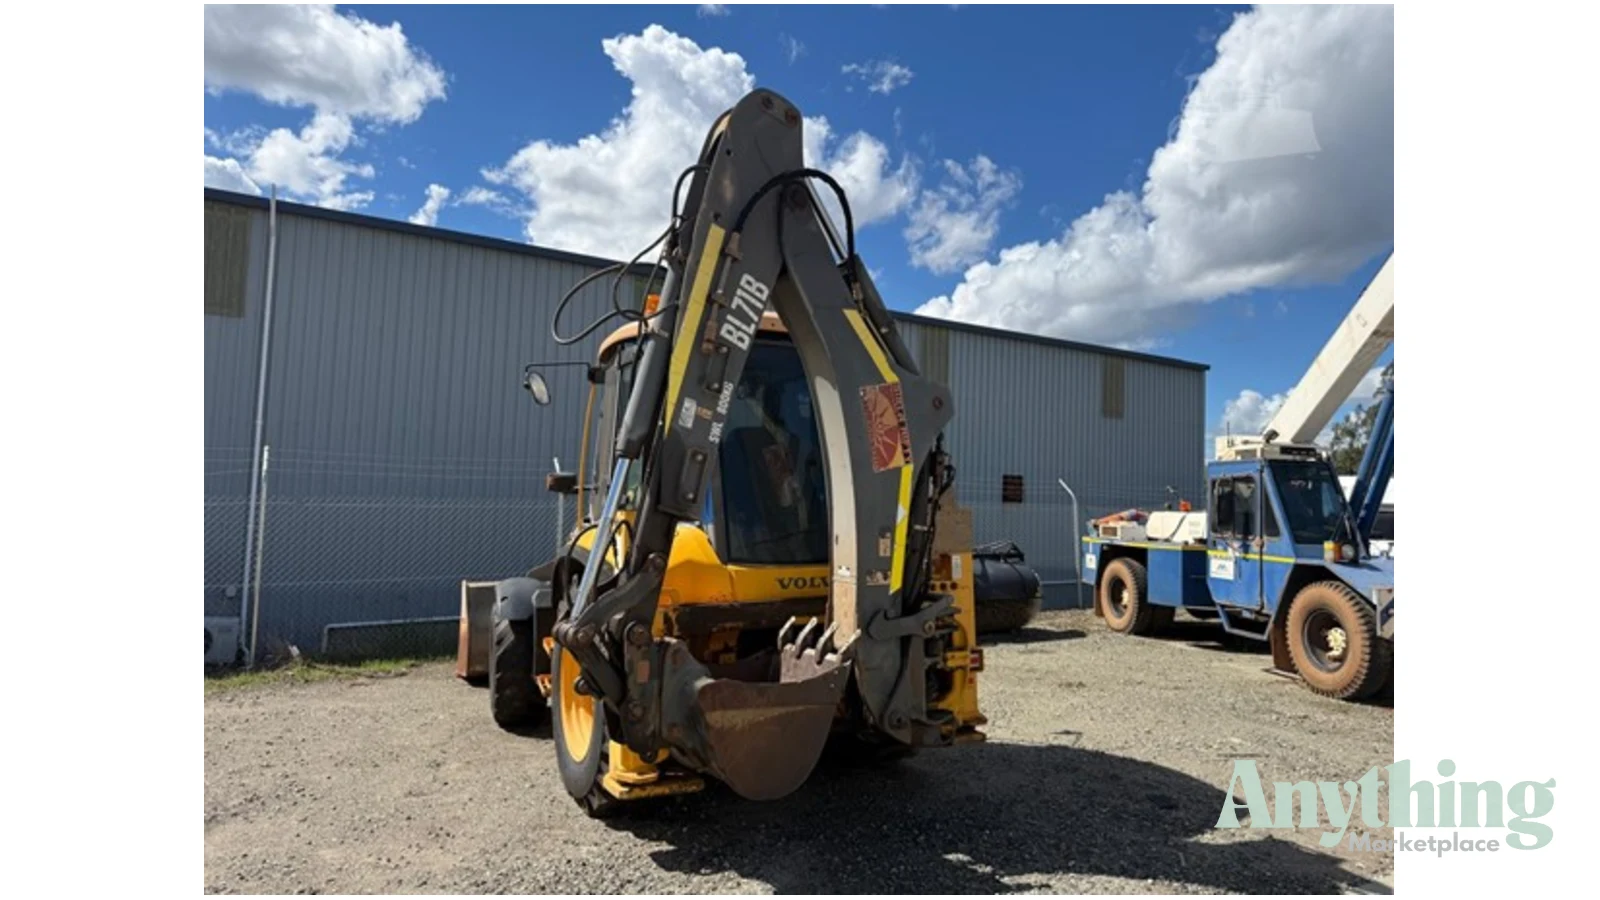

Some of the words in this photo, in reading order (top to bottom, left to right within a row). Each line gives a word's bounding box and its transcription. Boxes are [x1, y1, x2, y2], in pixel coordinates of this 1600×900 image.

[720, 273, 769, 350] BL71B
[709, 421, 724, 443] SWL
[775, 576, 829, 590] VOLV
